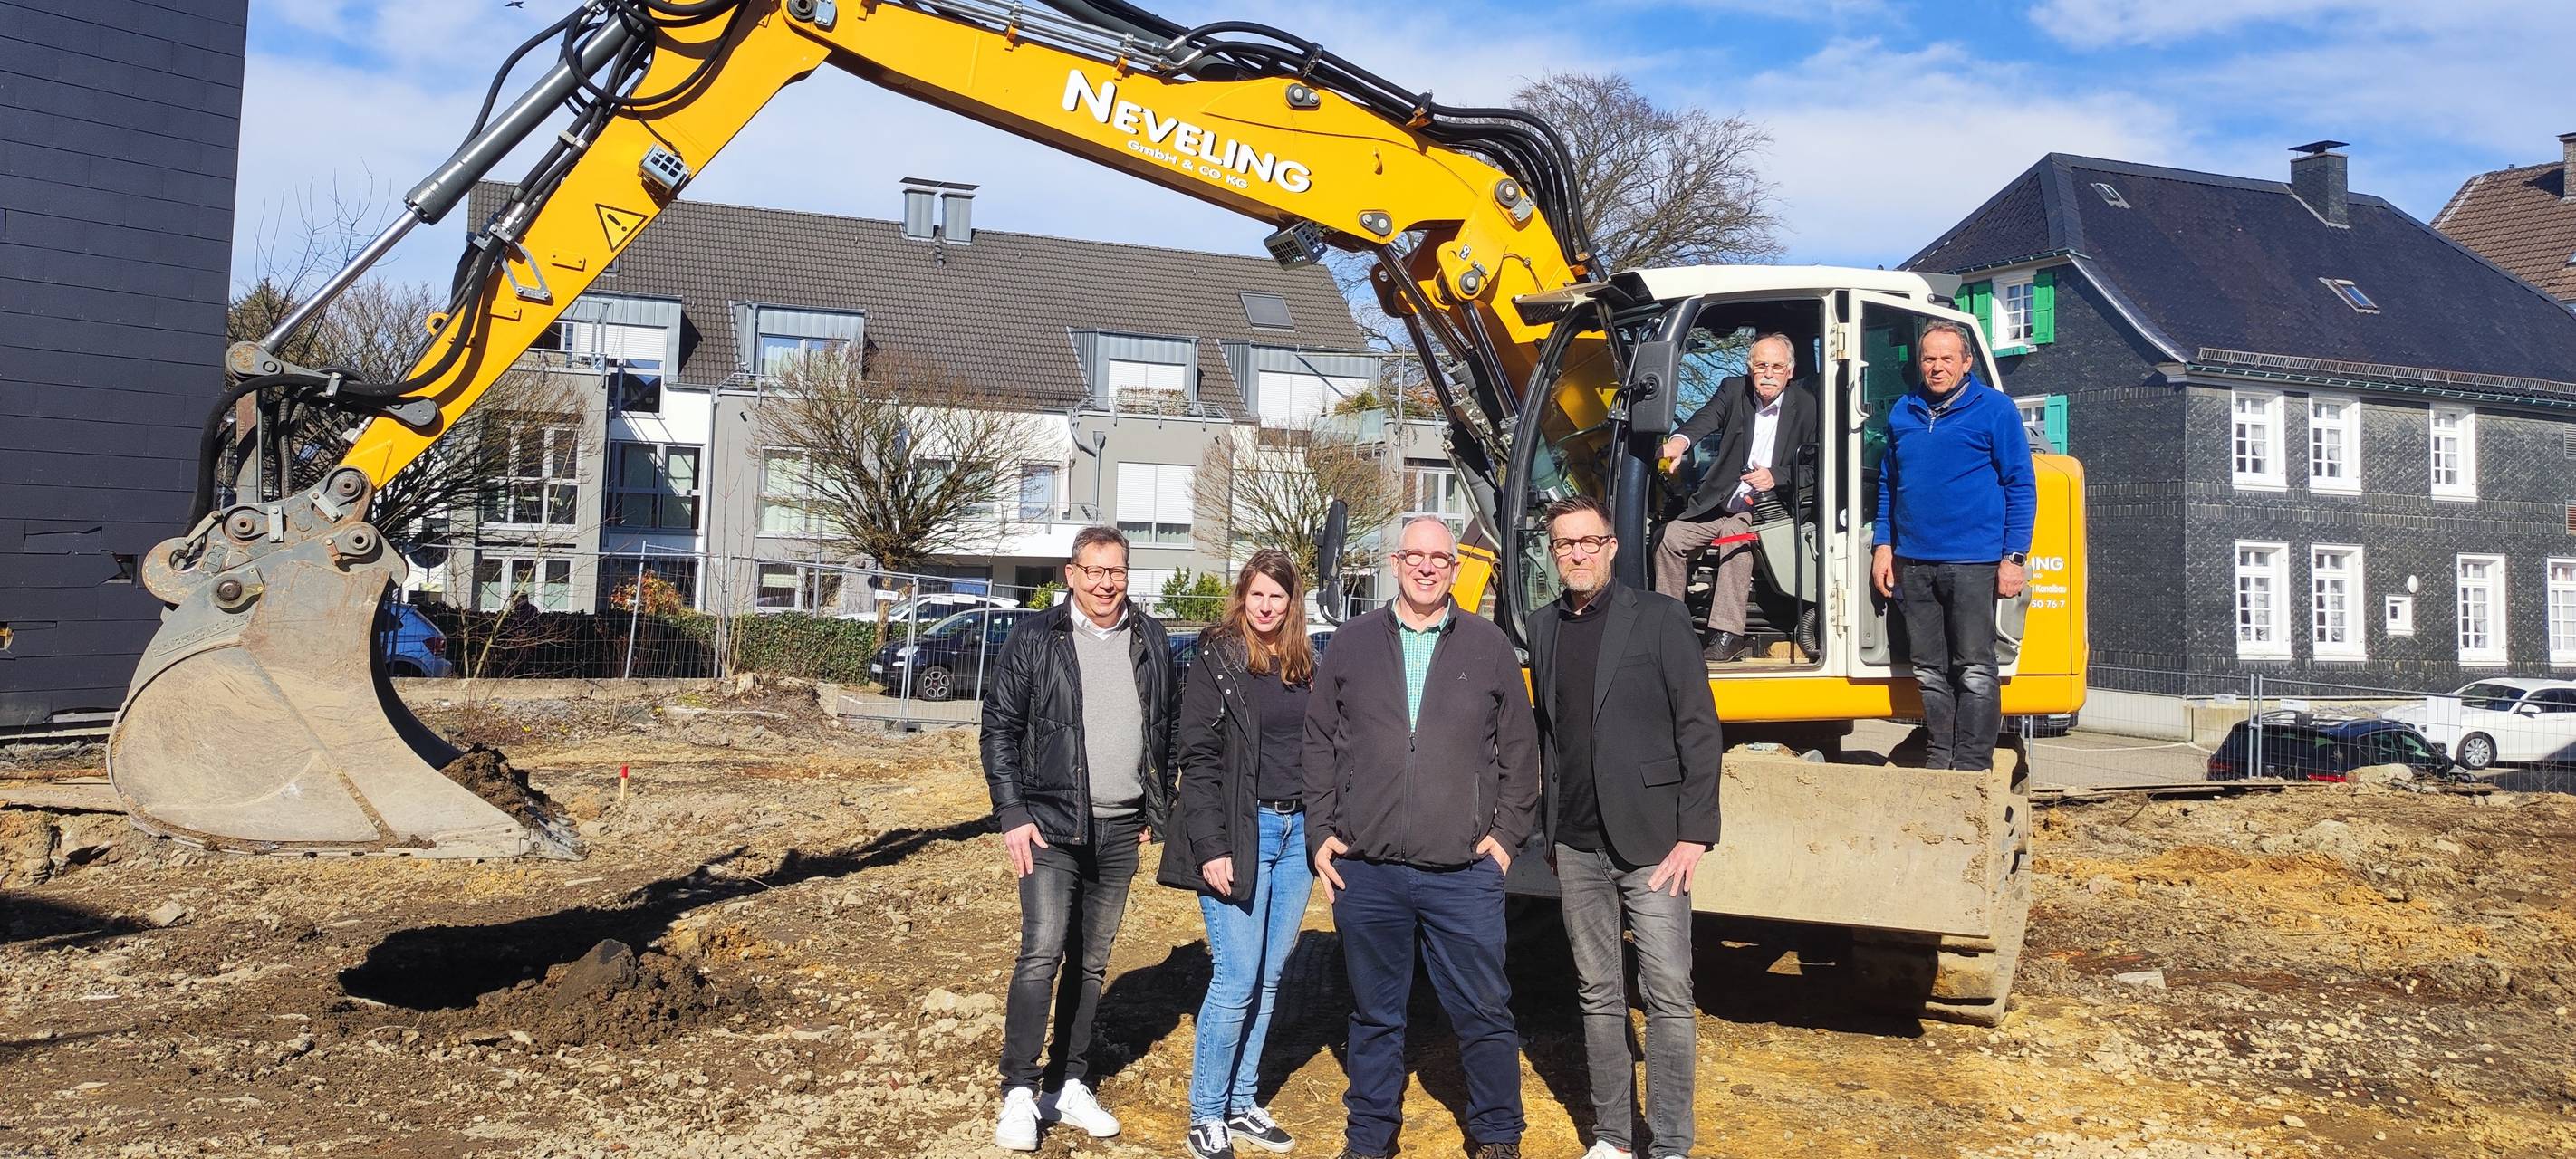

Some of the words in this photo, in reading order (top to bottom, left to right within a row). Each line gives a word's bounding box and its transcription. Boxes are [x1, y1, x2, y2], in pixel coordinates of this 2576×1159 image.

[1062, 69, 1312, 193] NEVELING
[1127, 139, 1178, 165] GmbH
[1181, 159, 1194, 172] &
[1226, 173, 1249, 188] KG
[2031, 556, 2064, 570] ING
